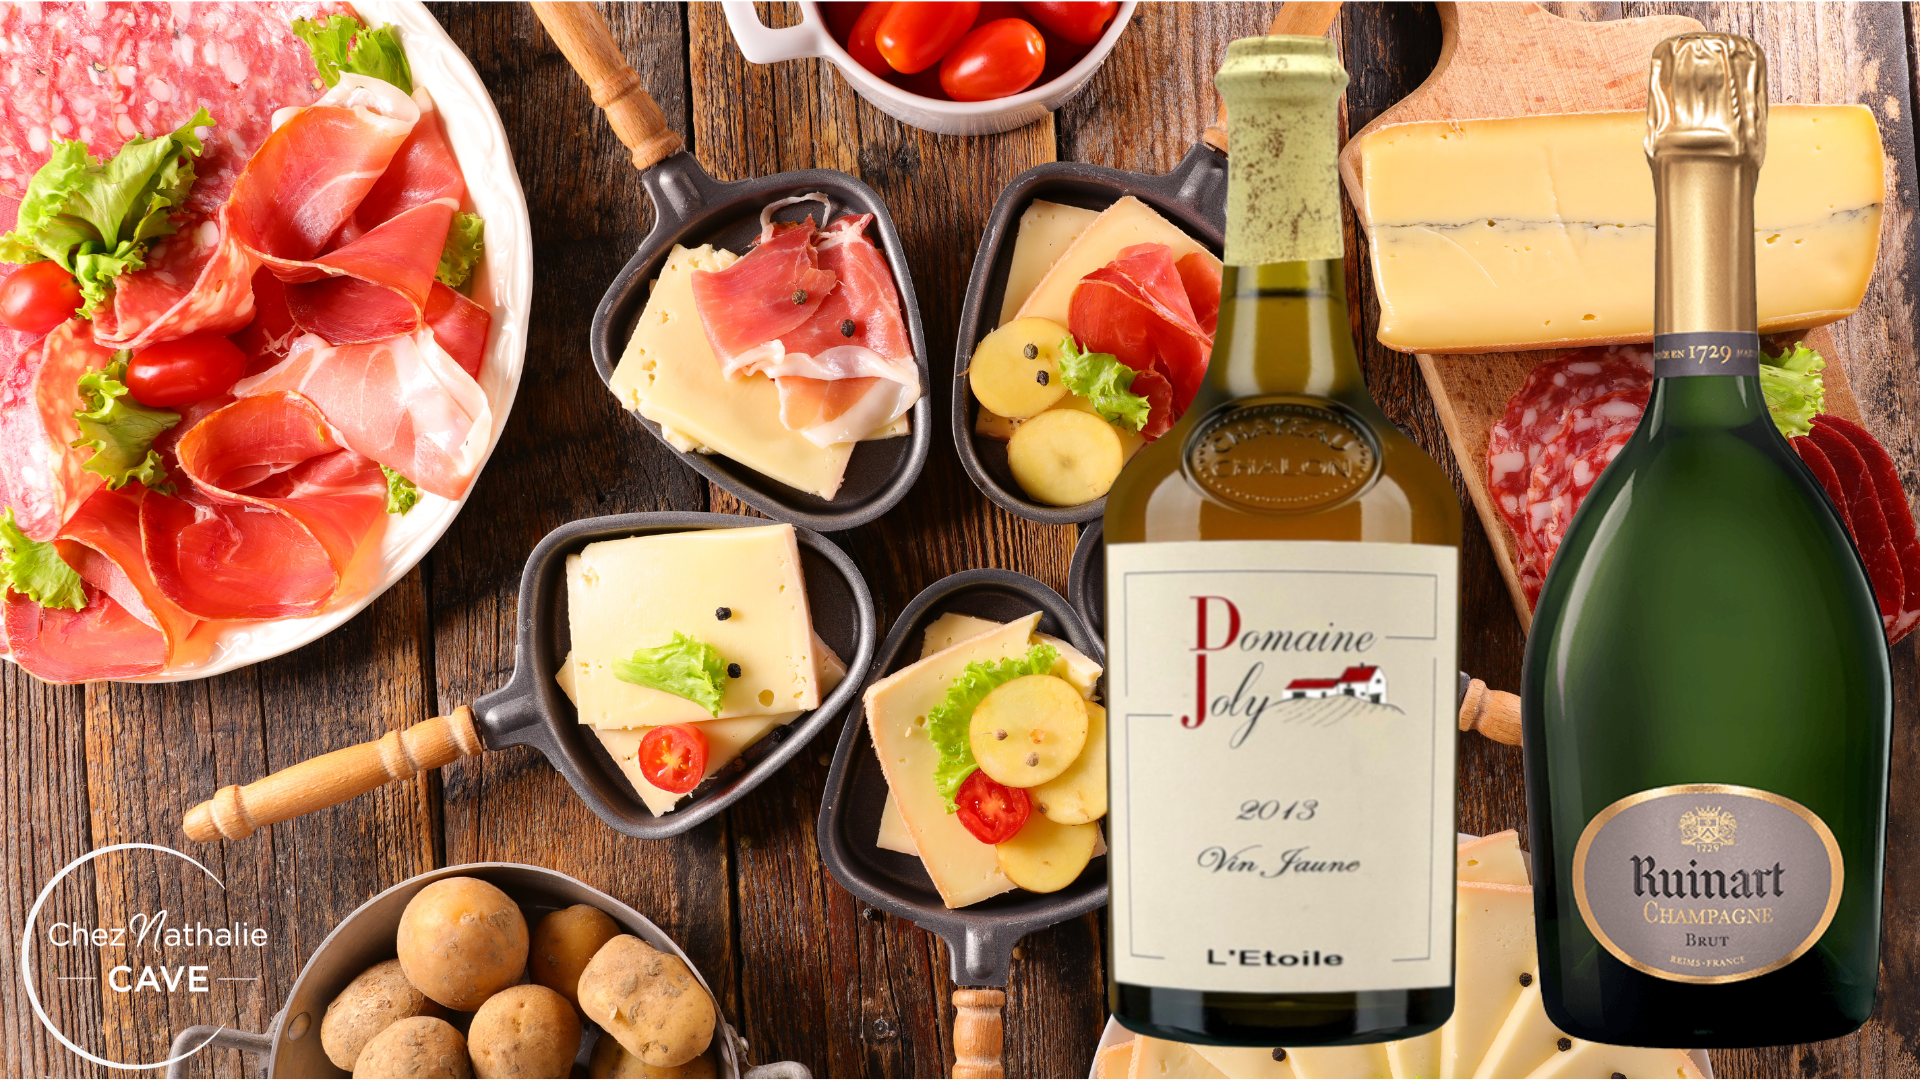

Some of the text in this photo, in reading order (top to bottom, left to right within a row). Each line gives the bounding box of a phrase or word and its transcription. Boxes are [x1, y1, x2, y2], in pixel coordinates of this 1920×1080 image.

[1688, 345, 1732, 364] 1729
[1211, 457, 1353, 479] CHALON
[1189, 596, 1378, 652] Domaine
[1181, 653, 1270, 749] Joly
[1236, 799, 1319, 821] 2013
[1696, 844, 1720, 853] 1729
[1197, 845, 1360, 878] Vin Jaune
[1630, 855, 1786, 898] Ruinart
[1643, 901, 1774, 924] CHAMPAGNE
[1685, 933, 1730, 947] BRUT
[1207, 949, 1344, 967] L'Etoile
